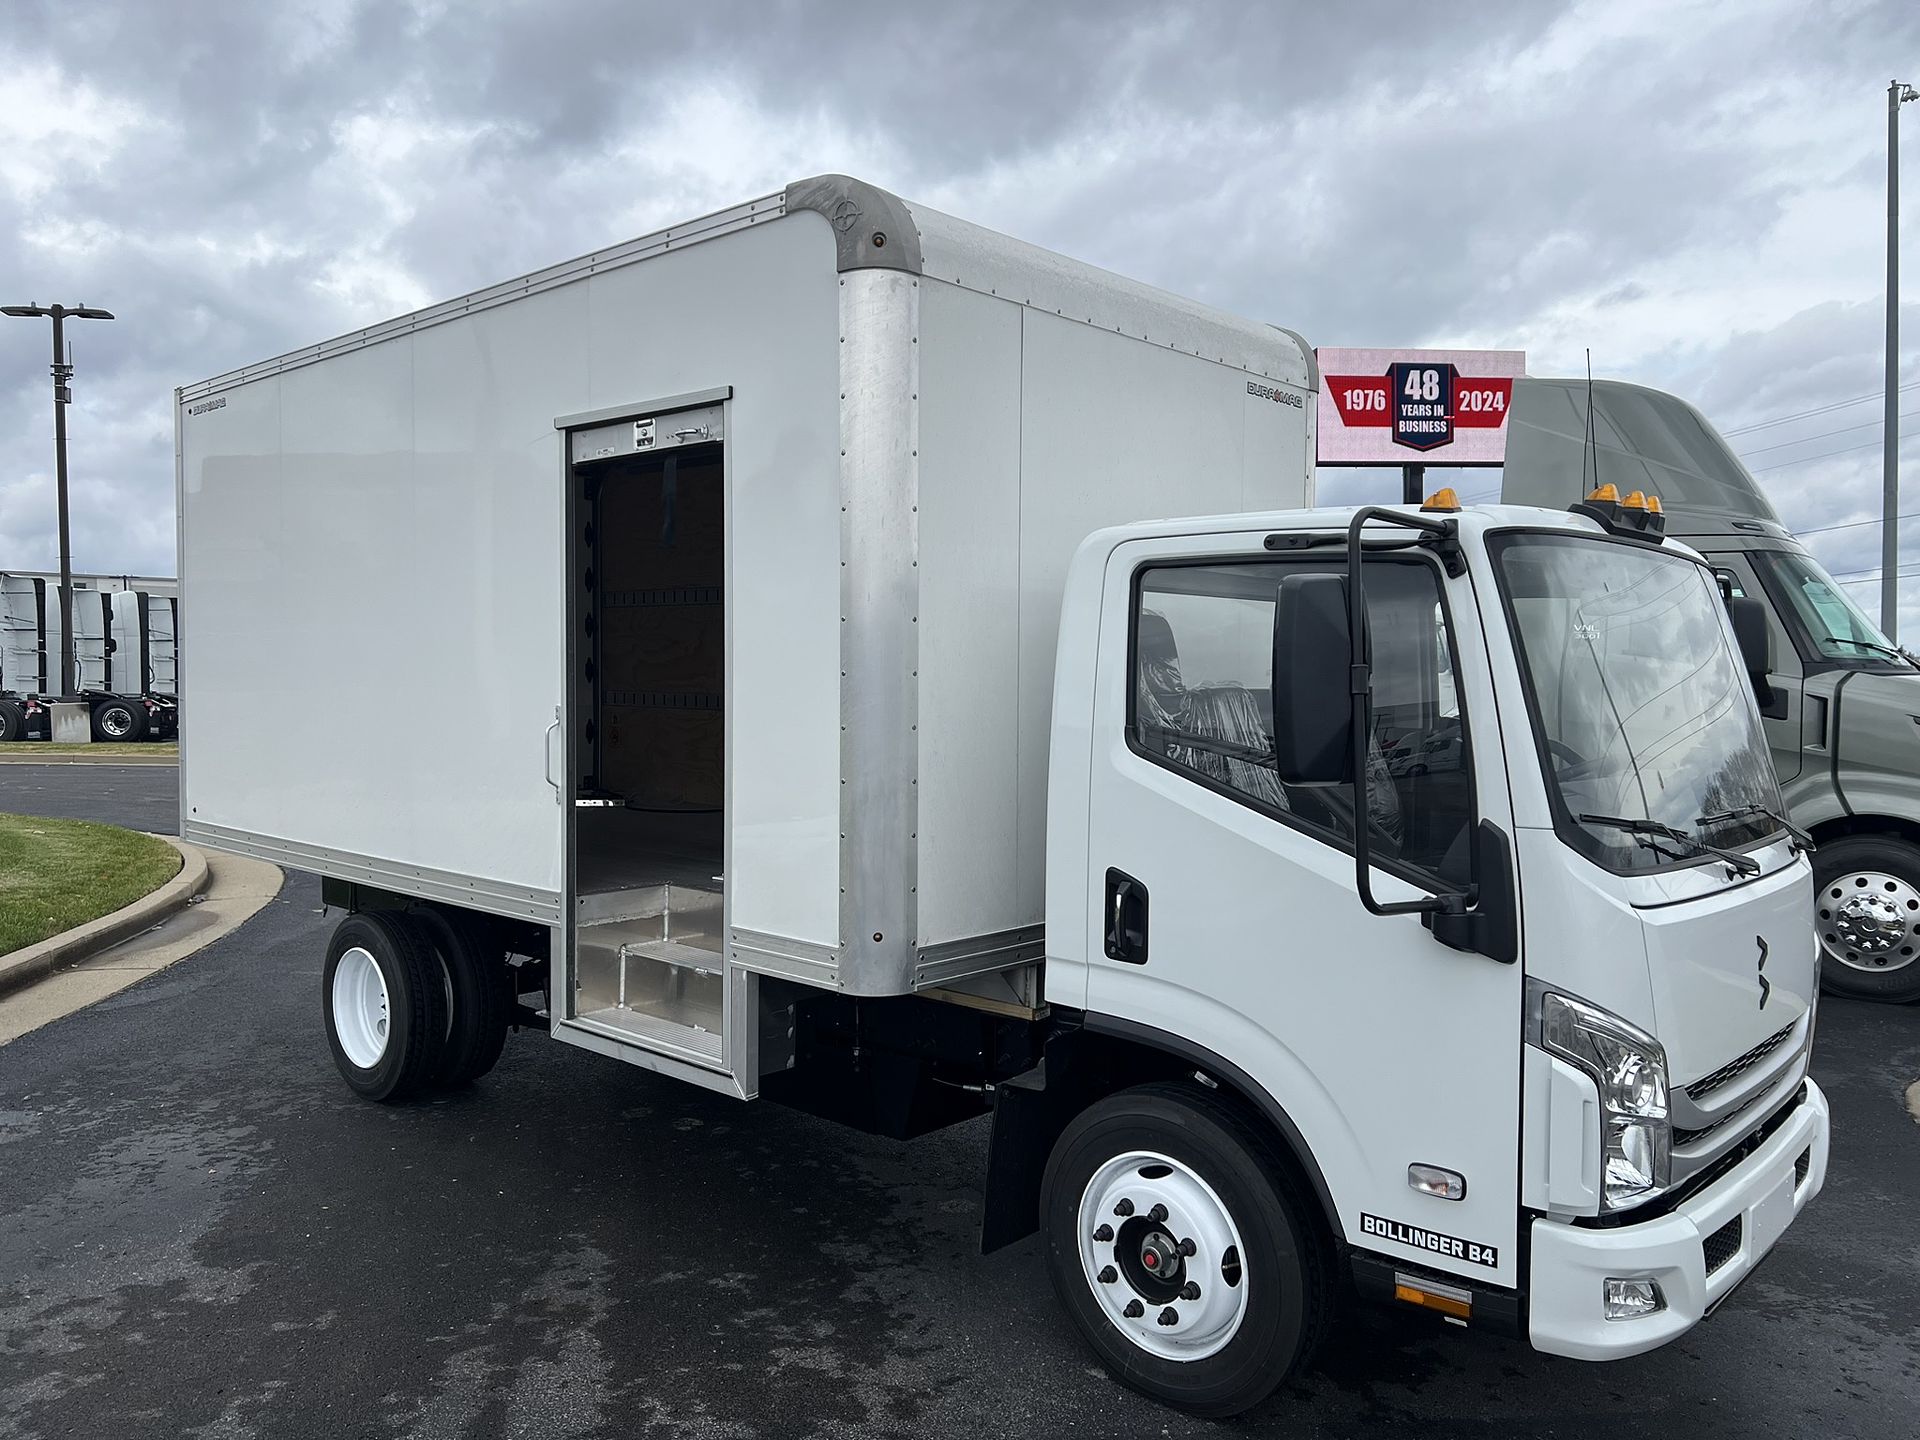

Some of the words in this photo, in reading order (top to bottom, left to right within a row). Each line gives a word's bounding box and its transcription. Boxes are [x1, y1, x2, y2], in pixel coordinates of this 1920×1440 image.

[1246, 381, 1303, 409] DURAMAG
[1404, 369, 1440, 401] 48
[1343, 389, 1386, 411] 1976
[1401, 404, 1432, 417] YEARS
[1433, 404, 1444, 417] IN
[1459, 390, 1504, 412] 2024
[1399, 420, 1447, 433] BUSINESS
[1363, 1215, 1464, 1258] BOLLINGER
[1468, 1243, 1495, 1266] B4
